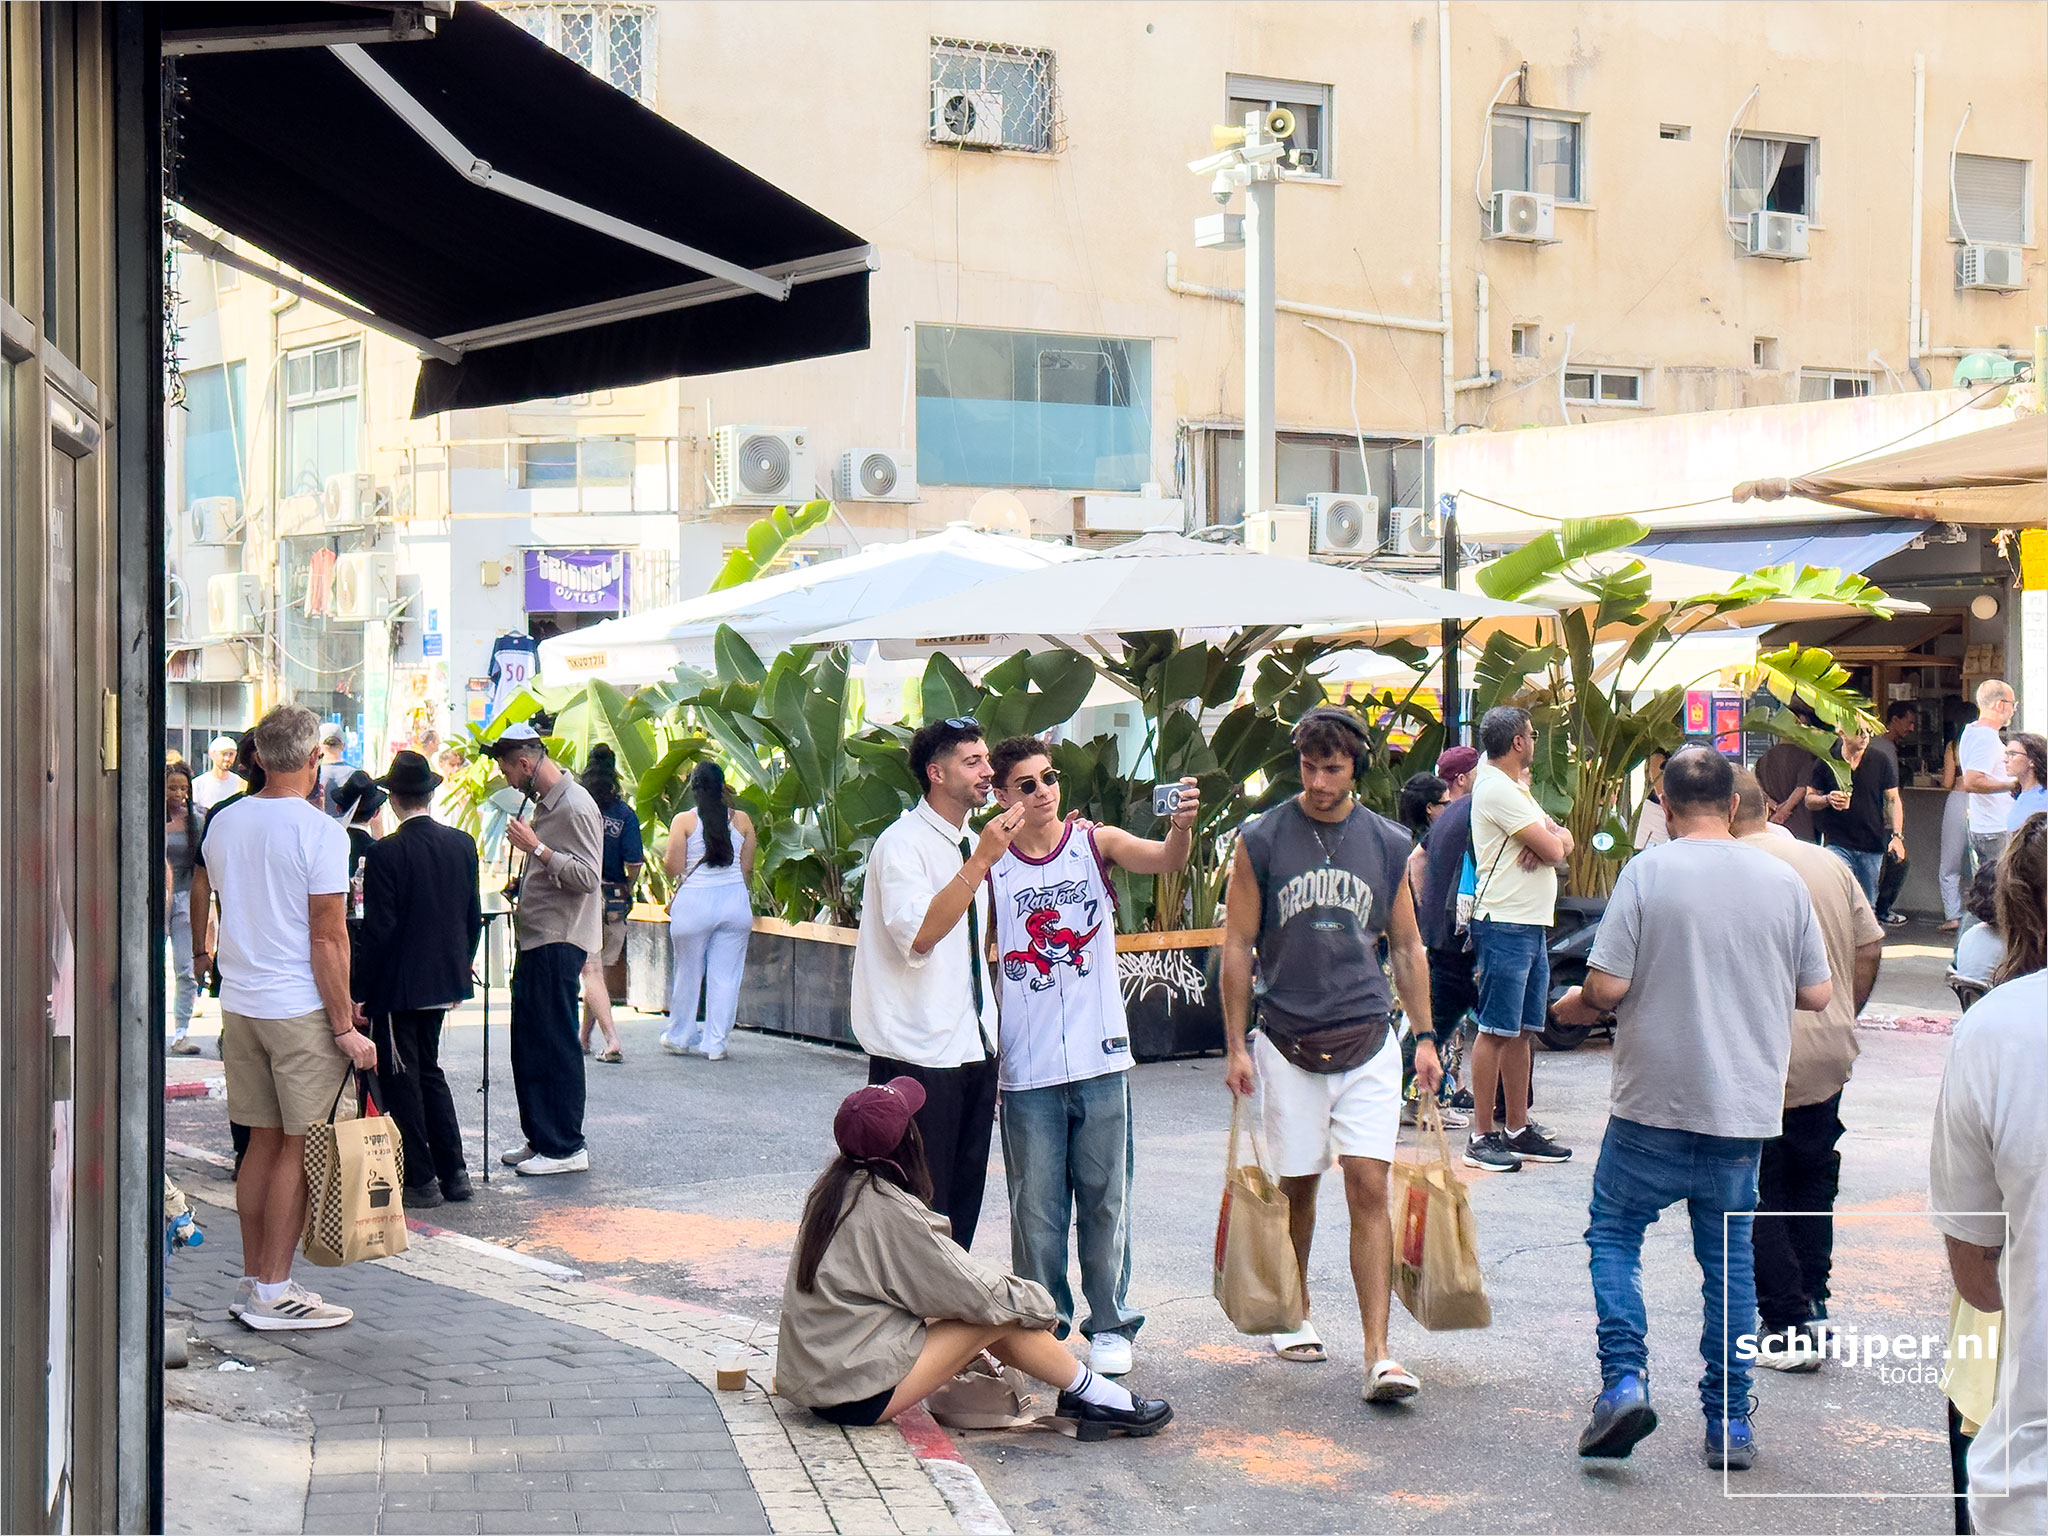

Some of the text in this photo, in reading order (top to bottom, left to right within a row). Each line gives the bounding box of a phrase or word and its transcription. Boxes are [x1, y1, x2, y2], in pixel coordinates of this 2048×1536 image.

[555, 585, 606, 604] OUTLET
[505, 663, 525, 682] 50
[1277, 868, 1374, 929] BROOKLYN
[1084, 899, 1098, 927] 7
